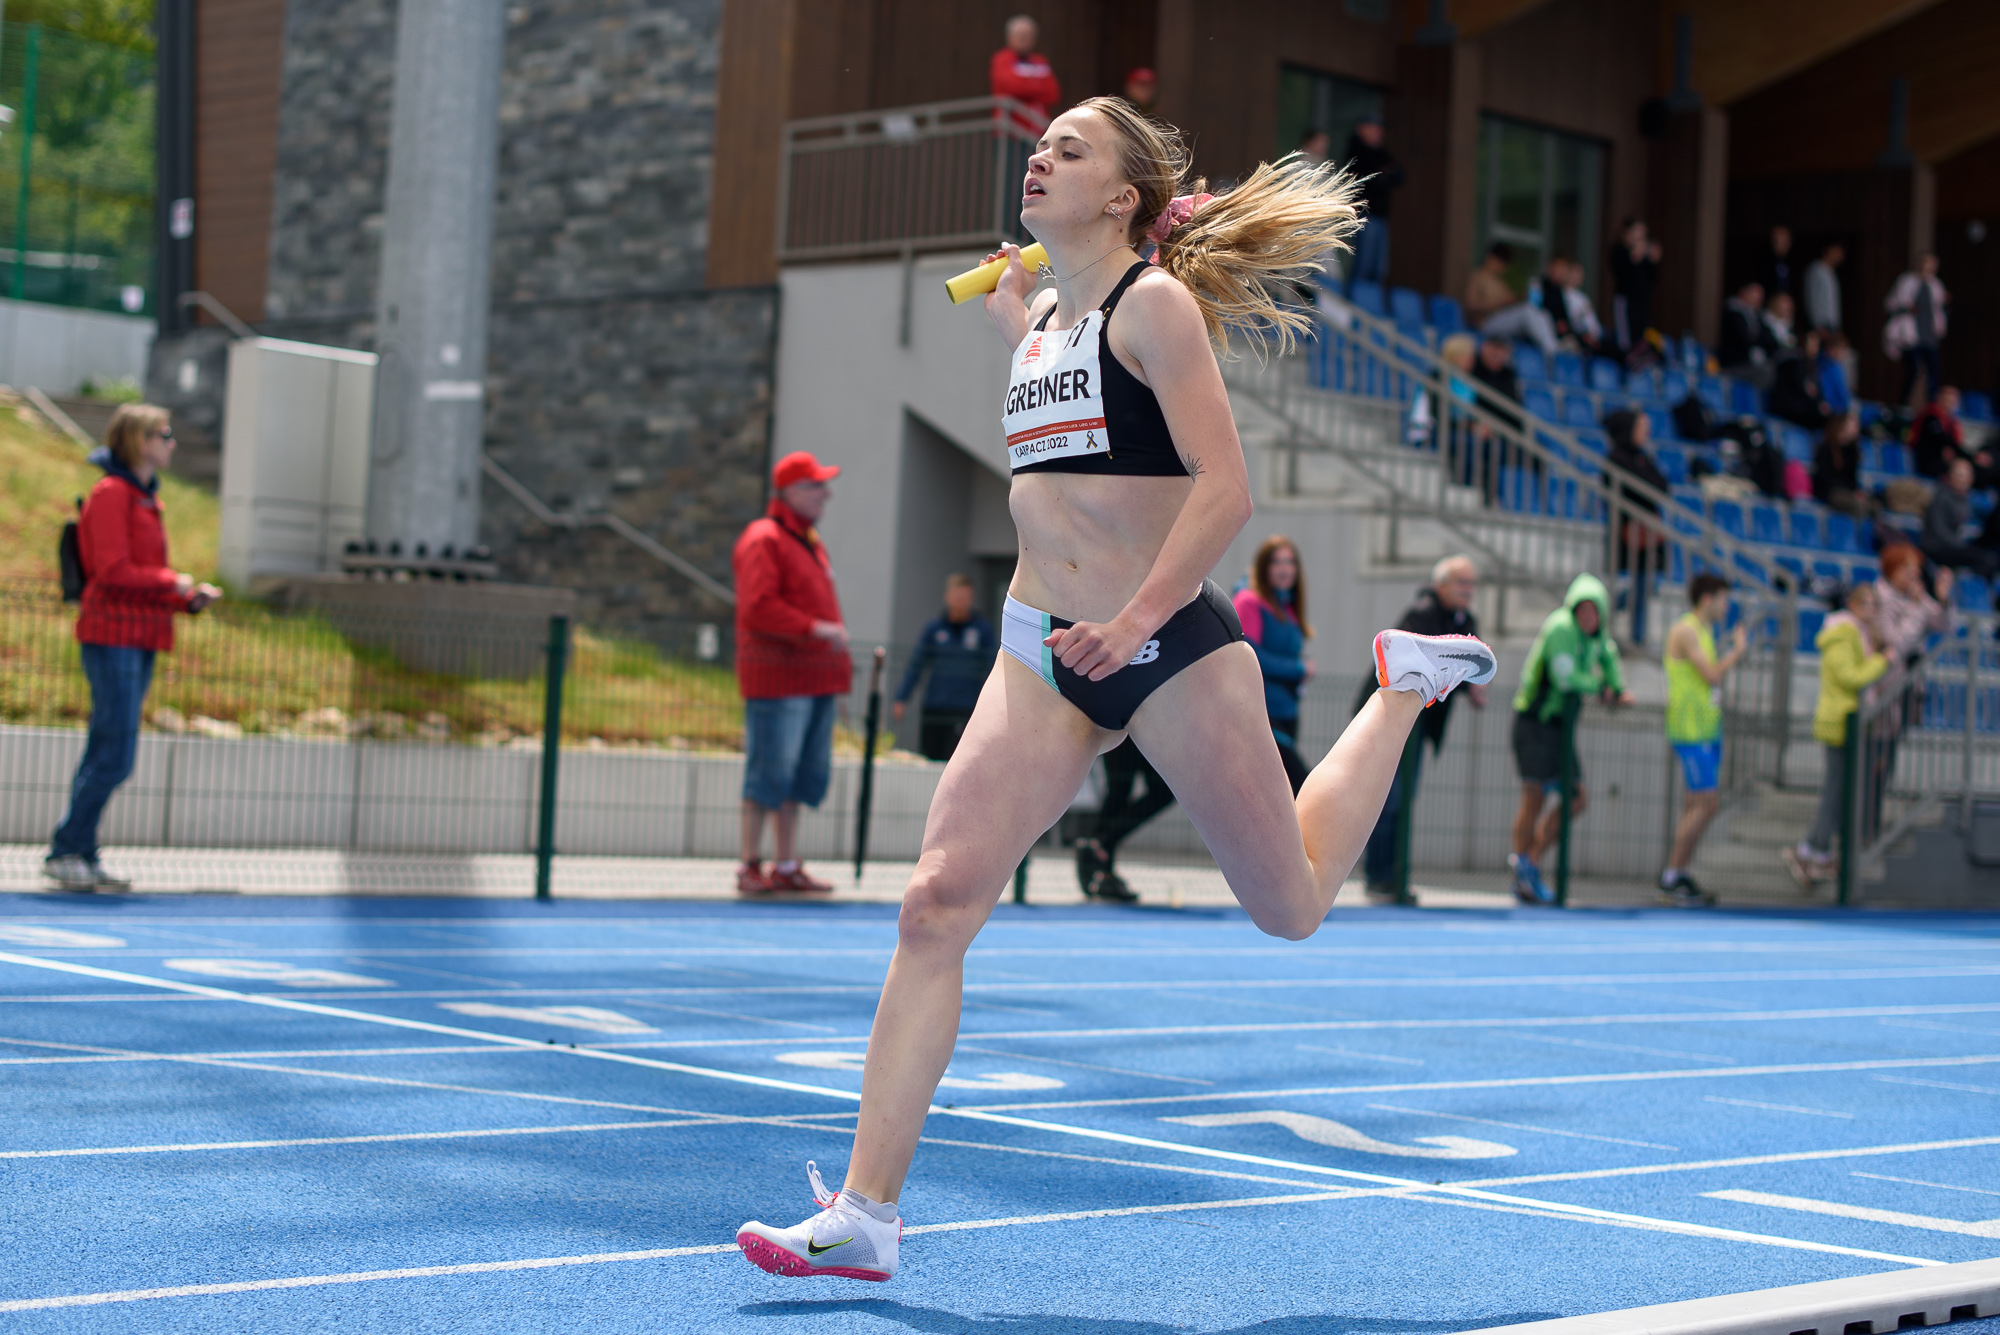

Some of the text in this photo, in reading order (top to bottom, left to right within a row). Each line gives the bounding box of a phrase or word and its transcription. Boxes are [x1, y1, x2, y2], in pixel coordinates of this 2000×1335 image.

[1006, 368, 1092, 416] GREINER
[435, 1001, 664, 1034] 4
[1156, 1110, 1519, 1160] 2
